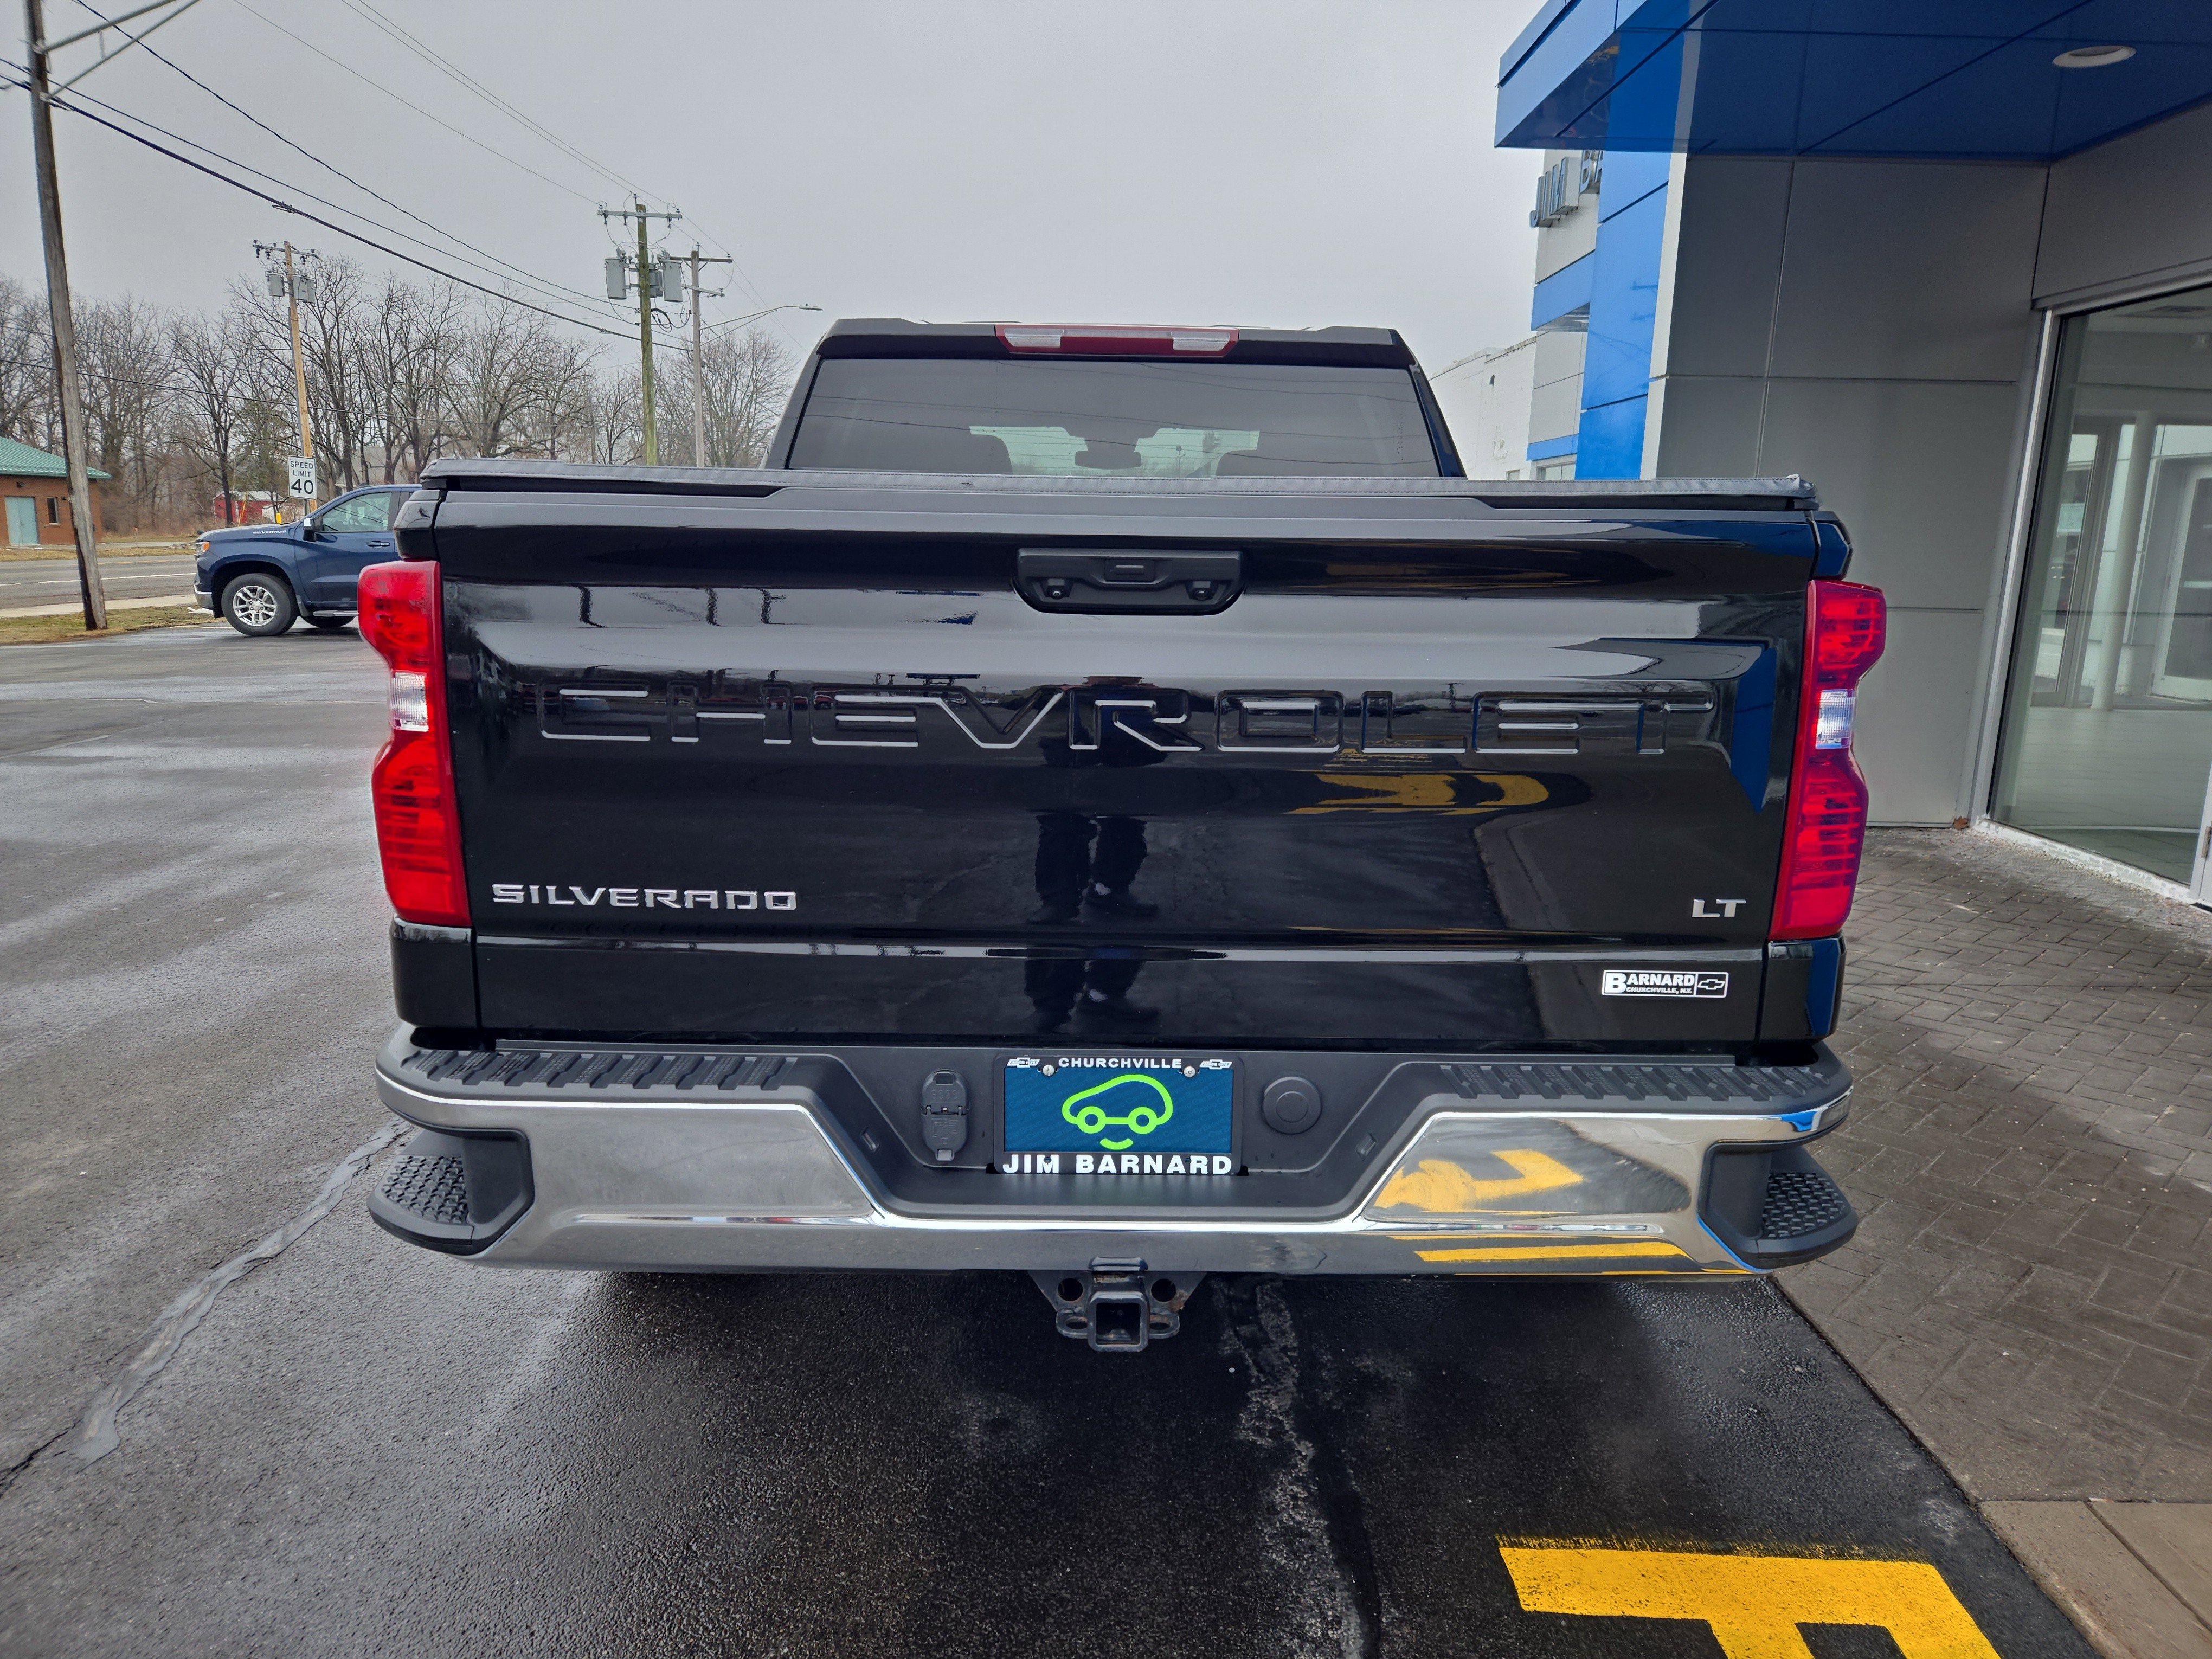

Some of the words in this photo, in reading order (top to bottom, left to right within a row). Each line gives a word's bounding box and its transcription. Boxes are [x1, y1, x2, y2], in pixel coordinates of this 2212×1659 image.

[1529, 156, 1571, 228] JIM
[290, 461, 313, 469] SPEED
[291, 479, 314, 494] 40
[538, 679, 1714, 754] CHEVROLET
[492, 884, 797, 910] SILVERADO
[1692, 899, 1747, 917] LT
[1604, 972, 1695, 993] BARNARD
[1058, 1058, 1182, 1069] CHURCHVILLE
[1002, 1154, 1059, 1174] JIM
[1076, 1154, 1232, 1175] BARNARD
